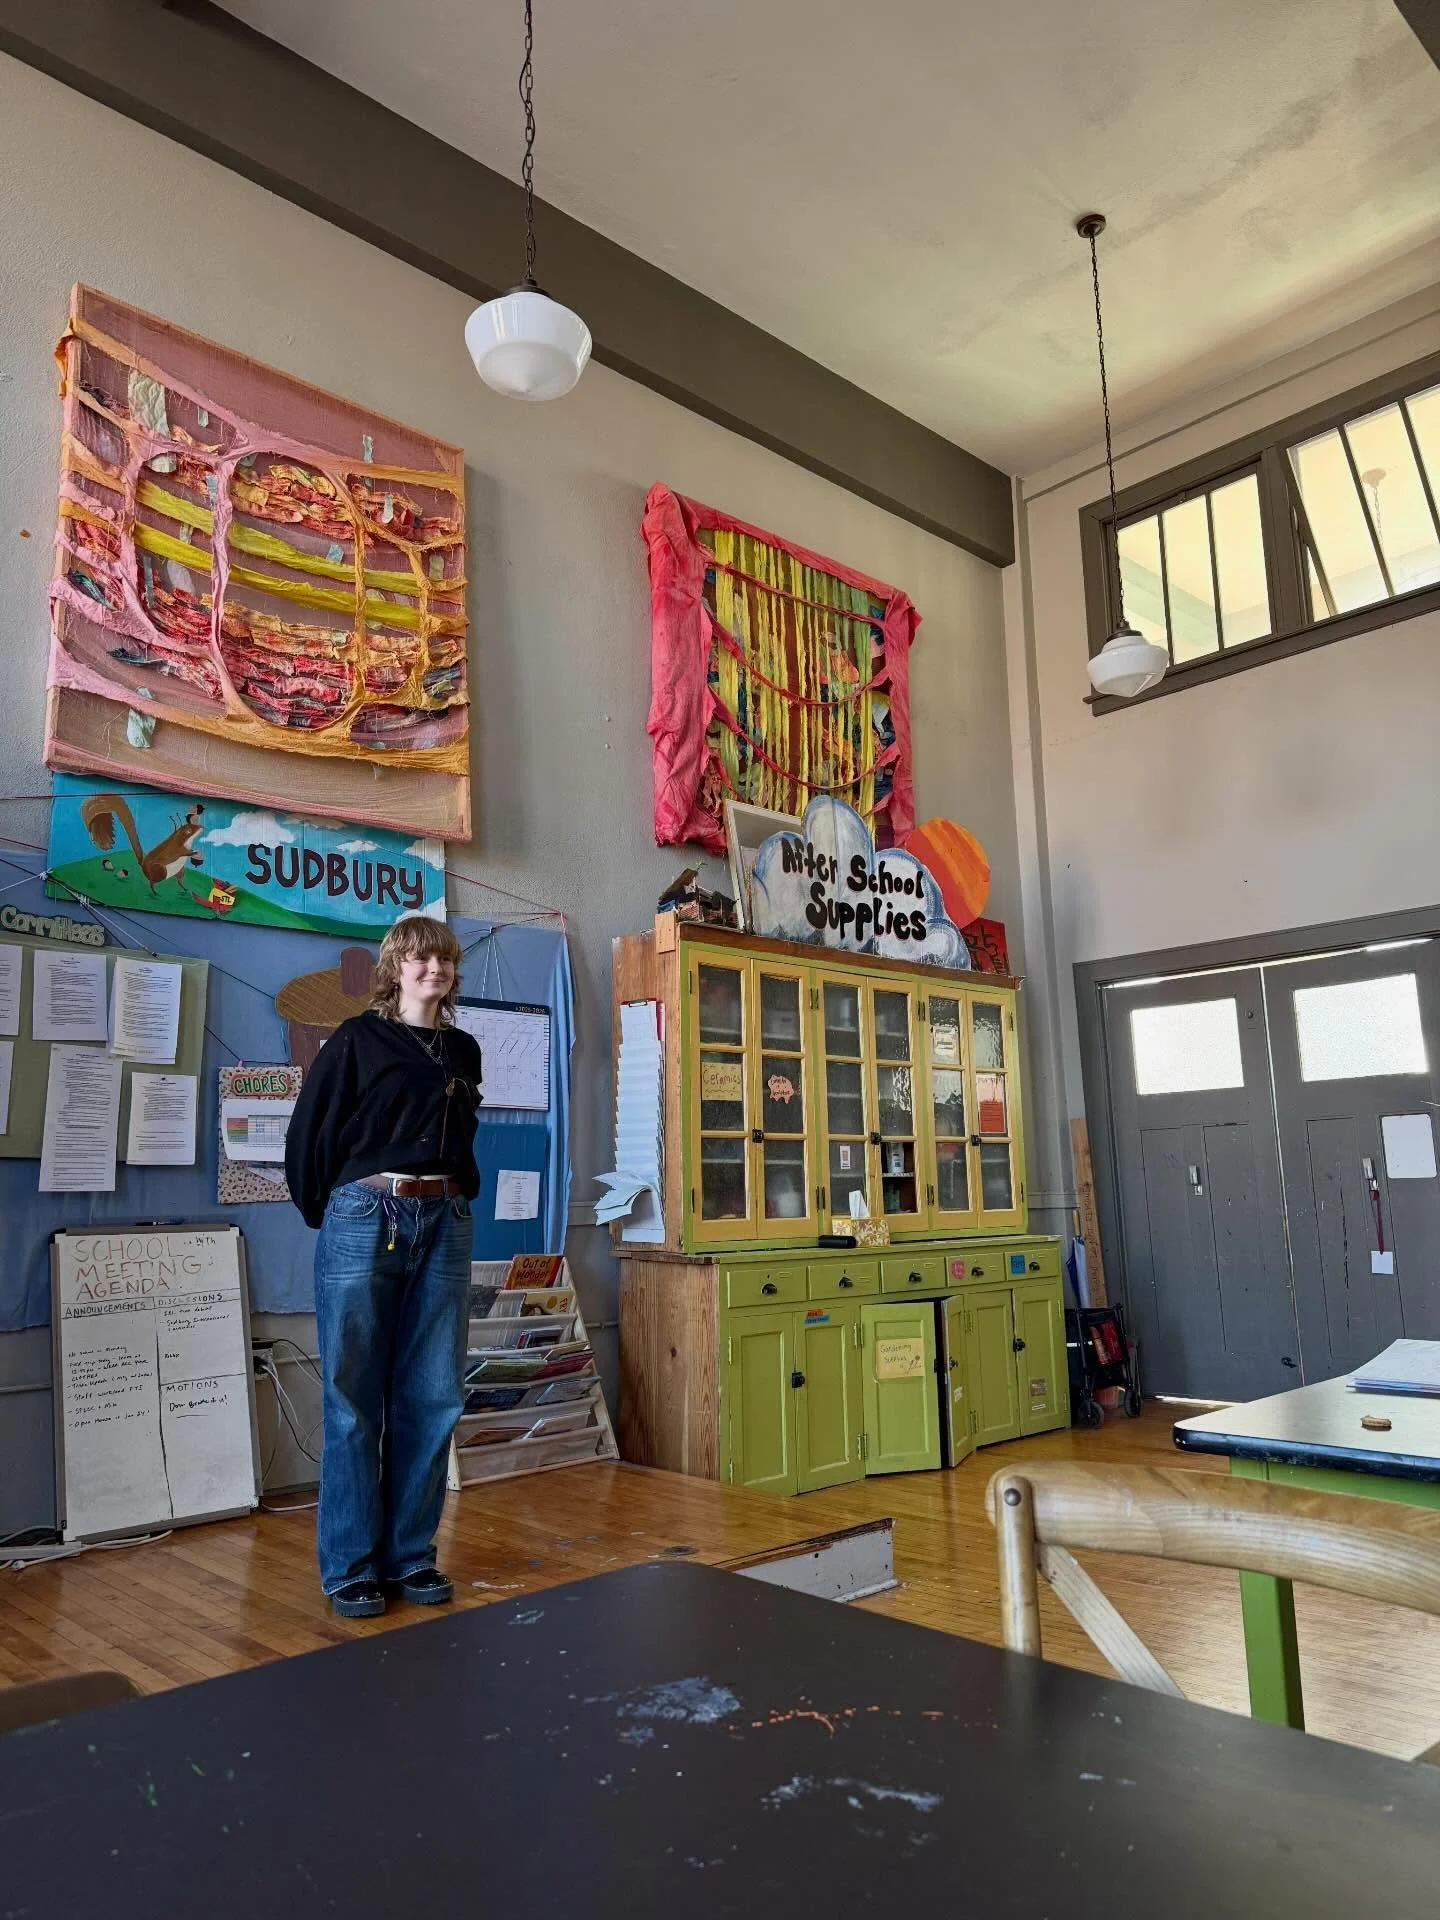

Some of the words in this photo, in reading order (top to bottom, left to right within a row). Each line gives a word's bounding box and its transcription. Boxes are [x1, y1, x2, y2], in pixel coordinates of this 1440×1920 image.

[244, 843, 424, 909] SUDBURY
[781, 838, 838, 884] After
[847, 855, 925, 898] School
[805, 881, 927, 941] Supplies
[234, 1074, 288, 1094] CHORES
[702, 1069, 741, 1085] Ceramics
[73, 1236, 183, 1263] SCHOOL
[75, 1256, 202, 1282] MEETING
[516, 1268, 550, 1280] Wonder
[522, 1257, 538, 1269] Out
[75, 1277, 170, 1301] AGENDA
[165, 1380, 219, 1393] MOTIONS
